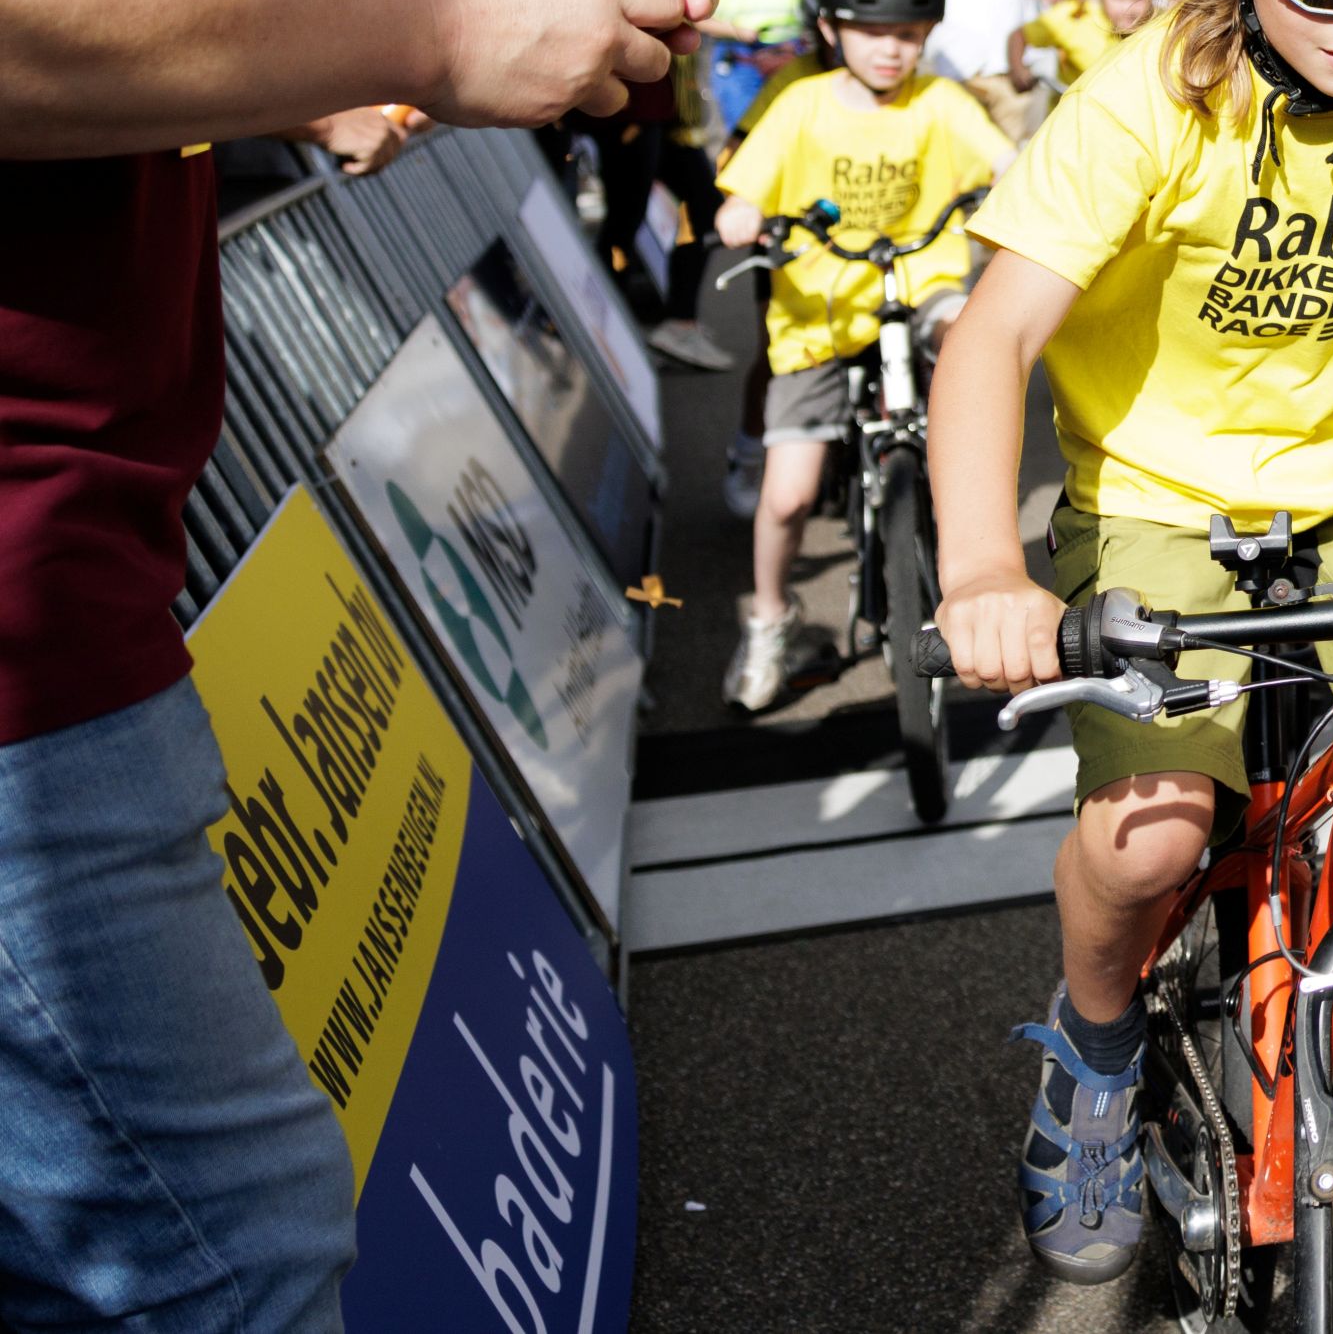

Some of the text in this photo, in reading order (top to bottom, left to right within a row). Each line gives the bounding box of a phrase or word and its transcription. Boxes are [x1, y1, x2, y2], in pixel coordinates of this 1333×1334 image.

[1197, 302, 1315, 338] RACE
[446, 454, 538, 633] MSD
[1110, 616, 1146, 631] SHIMANO
[258, 620, 397, 846] Janssen
[308, 751, 447, 1111] WWW.JANSSENBEUGEN.NL
[409, 948, 590, 1334] baderie
